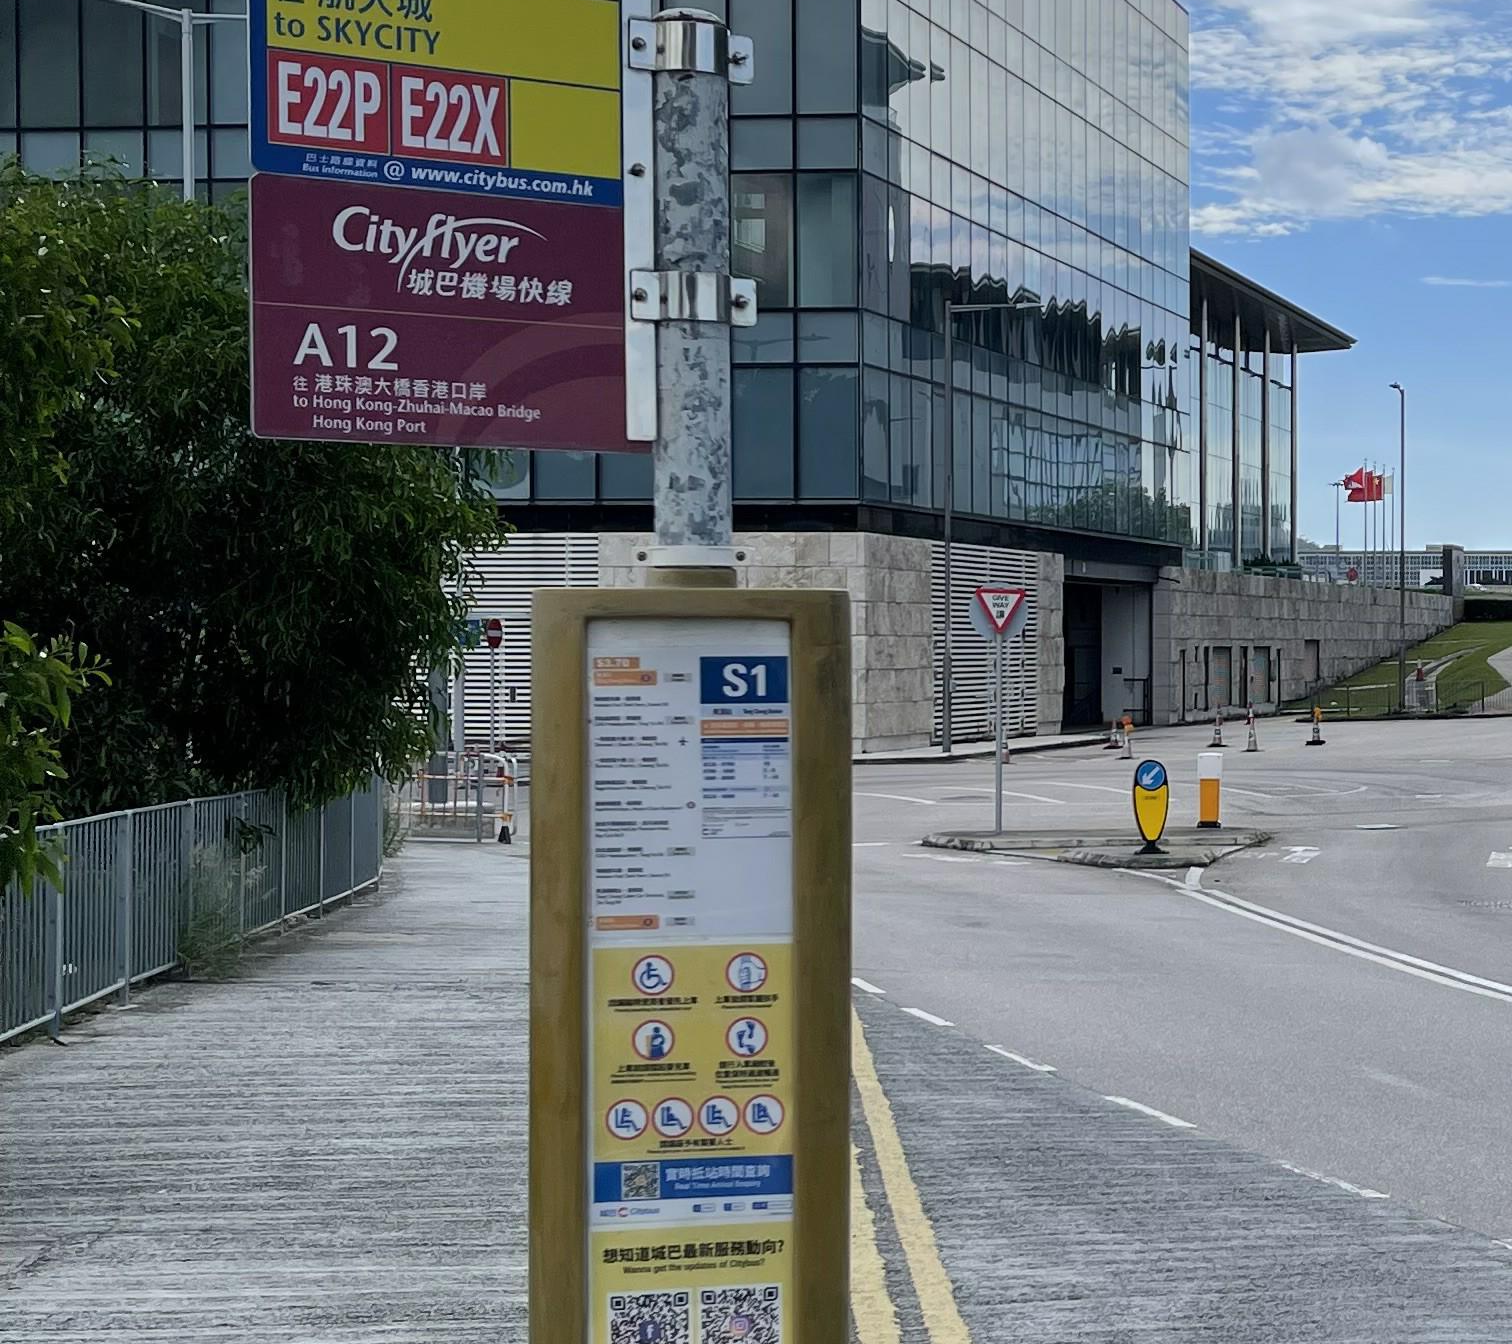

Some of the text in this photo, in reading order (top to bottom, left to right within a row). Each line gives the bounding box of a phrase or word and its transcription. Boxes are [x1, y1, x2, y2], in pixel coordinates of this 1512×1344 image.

[274, 12, 440, 55] to SKYCITY
[278, 60, 381, 142] E22P
[401, 76, 501, 156] E22X
[302, 163, 320, 172] Bus
[411, 166, 593, 196] www.citybus.com.hk
[407, 268, 573, 306] 城巴機場快線
[293, 323, 398, 371] A12
[293, 374, 487, 401] 往 港珠澳大橋香港口岸
[293, 395, 541, 422] to Hong Kong-Zhuhai-Macao Bridge
[313, 415, 426, 435] Hong Kong Port
[722, 663, 767, 697] S1
